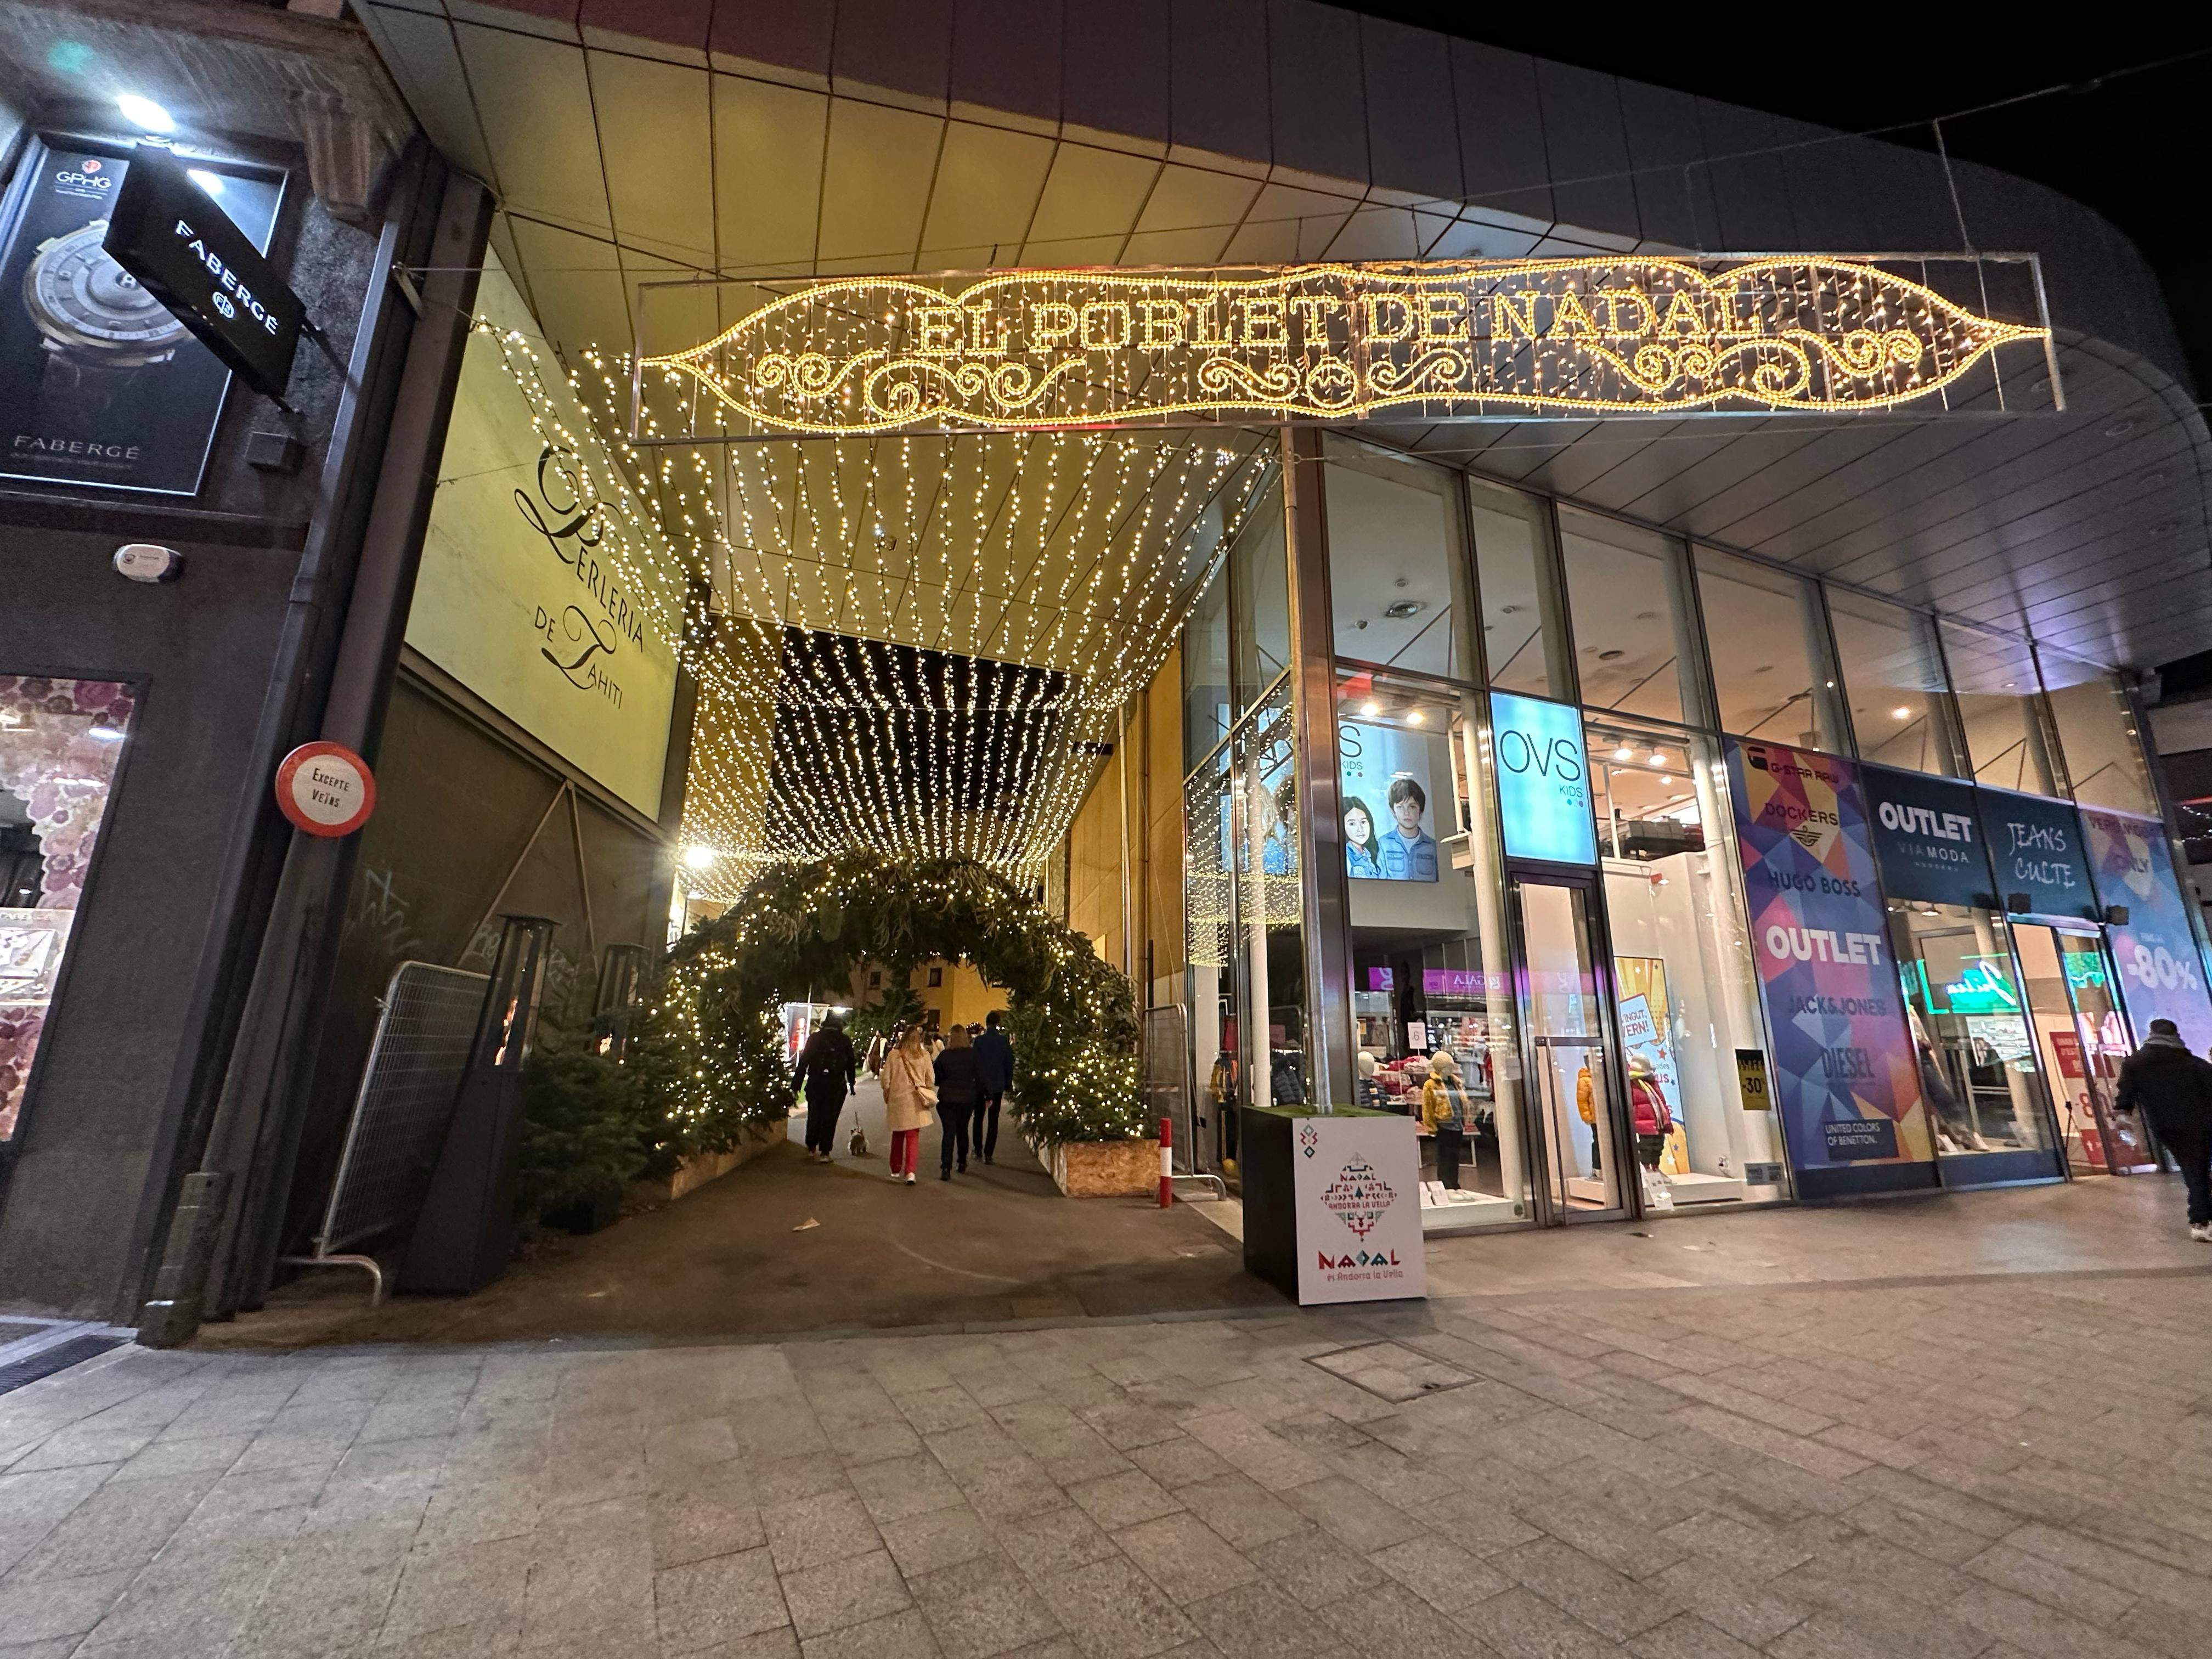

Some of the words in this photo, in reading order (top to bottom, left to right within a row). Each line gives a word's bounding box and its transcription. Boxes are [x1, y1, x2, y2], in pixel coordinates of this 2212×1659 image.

[56, 171, 112, 188] GPHG
[175, 219, 279, 335] FABERGÉ
[913, 298, 1009, 357] EL
[1029, 297, 1339, 353] POBLET
[1362, 292, 1469, 343] DE
[1491, 285, 1763, 342] NADAL
[14, 435, 140, 460] FABERGÉ
[535, 605, 556, 644] DE
[541, 605, 623, 709] TAHITI
[1500, 730, 1581, 782] OVS
[1771, 763, 1813, 780] G-STAR
[1559, 785, 1583, 798] KIDS
[1764, 803, 1838, 826] DOCKERS
[1878, 801, 1972, 843] OUTLET
[2007, 822, 2067, 856] JEANS
[1768, 871, 1816, 893] HUGO
[1820, 877, 1861, 898] BOSS
[1765, 925, 1882, 966] OUTLET
[2126, 944, 2198, 991] -80%
[1821, 1047, 1876, 1079] DIESEL
[1825, 1124, 1852, 1134] UNITED
[1852, 1122, 1881, 1133] COLORS
[1827, 1136, 1837, 1146] OF
[1340, 1173, 1376, 1182] NADAL
[1328, 1202, 1361, 1210] ANDORRA
[1318, 1248, 1401, 1270] NADAL
[1337, 1272, 1371, 1282] Andorra
[1373, 1270, 1381, 1279] la
[1383, 1268, 1403, 1279] Vella
